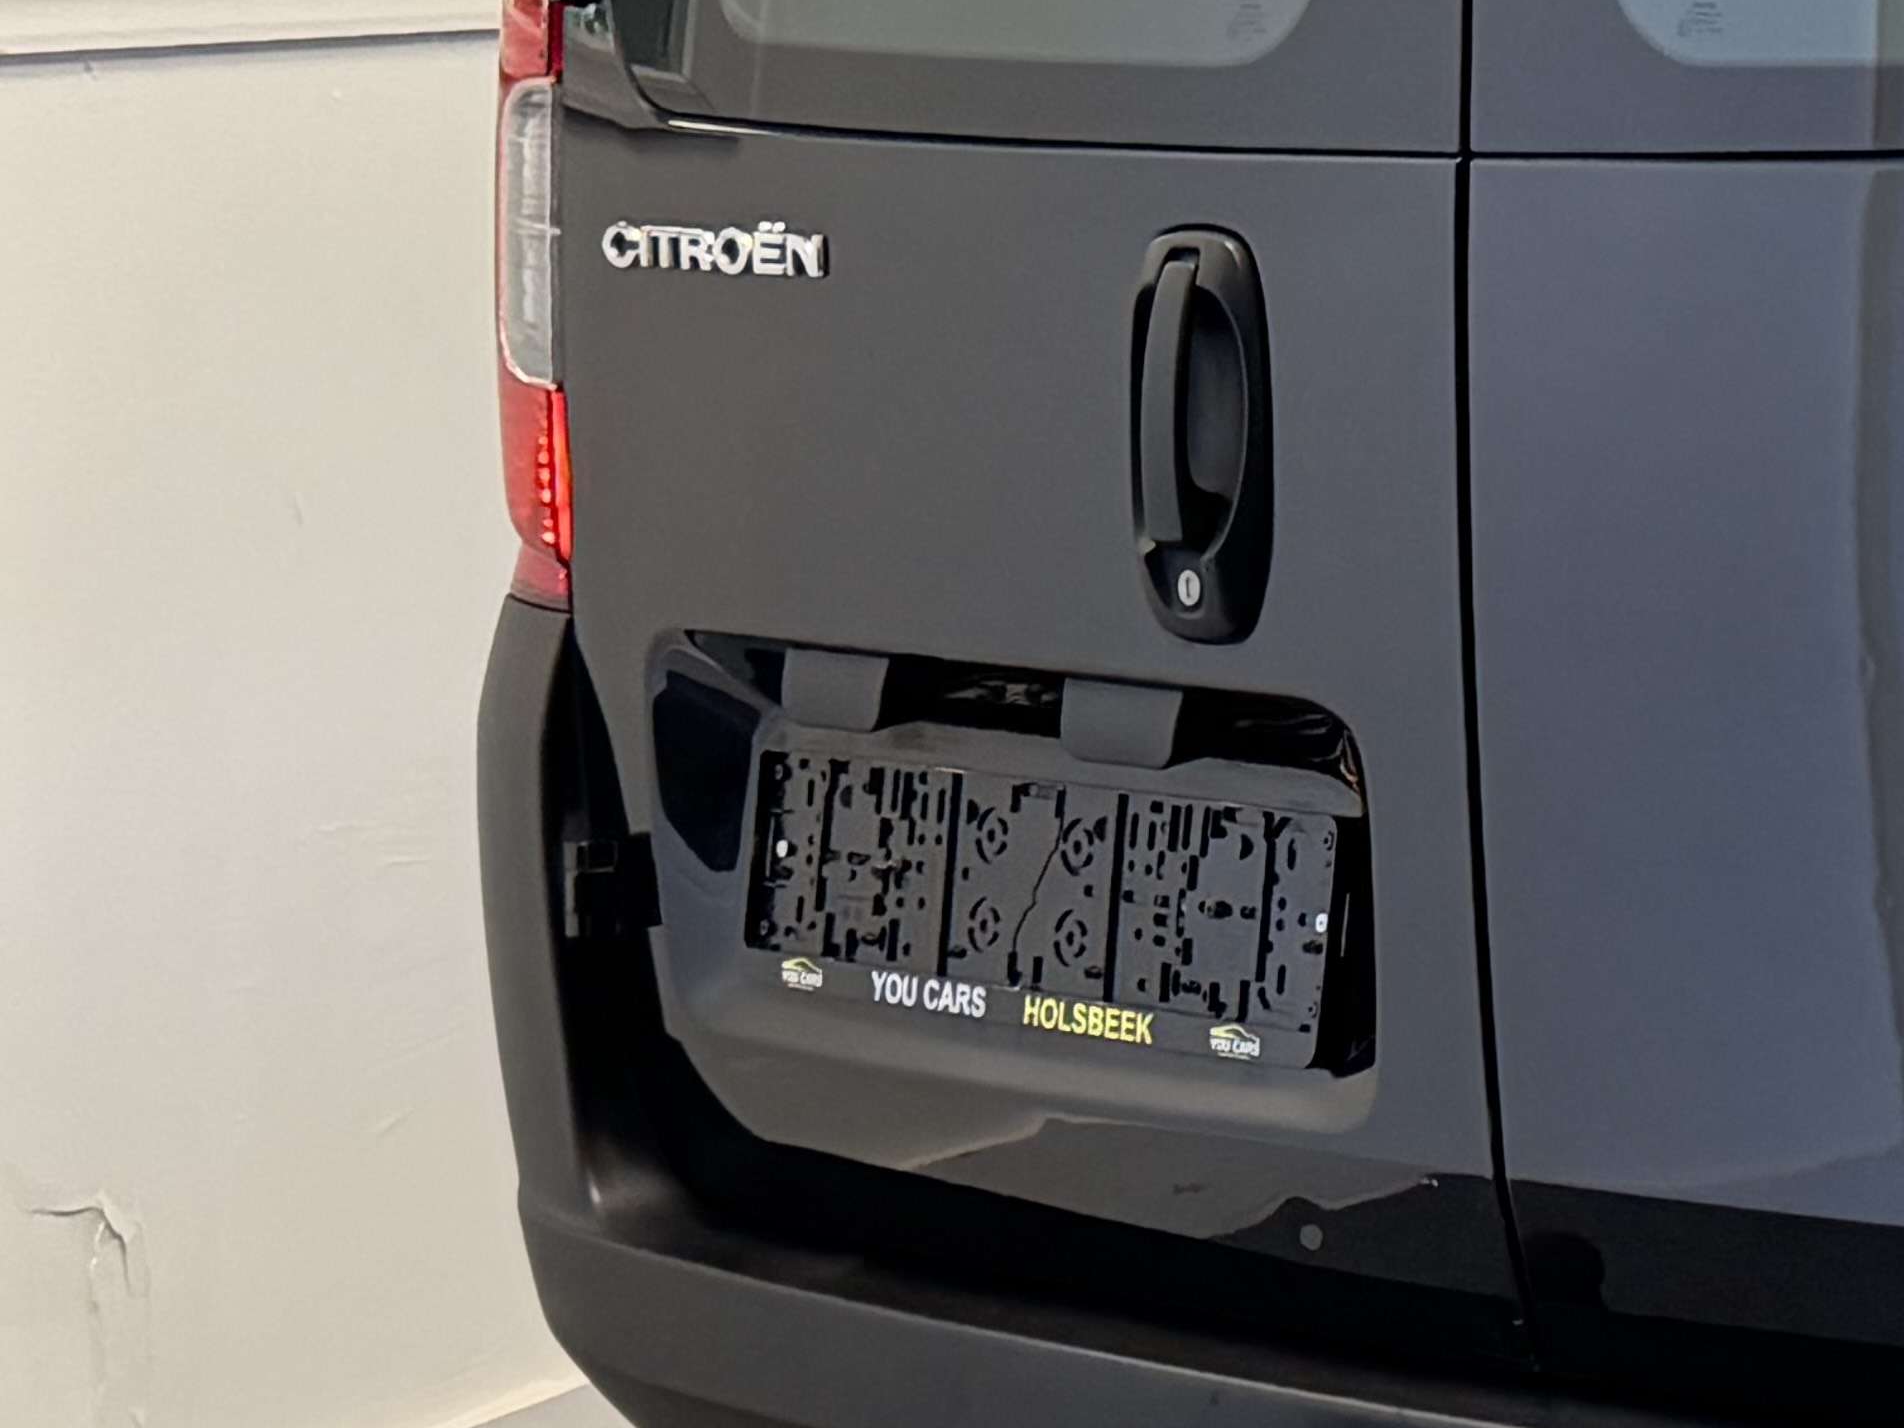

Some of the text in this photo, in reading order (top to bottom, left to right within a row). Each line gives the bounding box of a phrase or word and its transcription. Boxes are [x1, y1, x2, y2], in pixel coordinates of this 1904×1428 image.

[602, 220, 829, 278] CITROËN
[871, 971, 1154, 1045] YOU CARS HOLSBEEK
